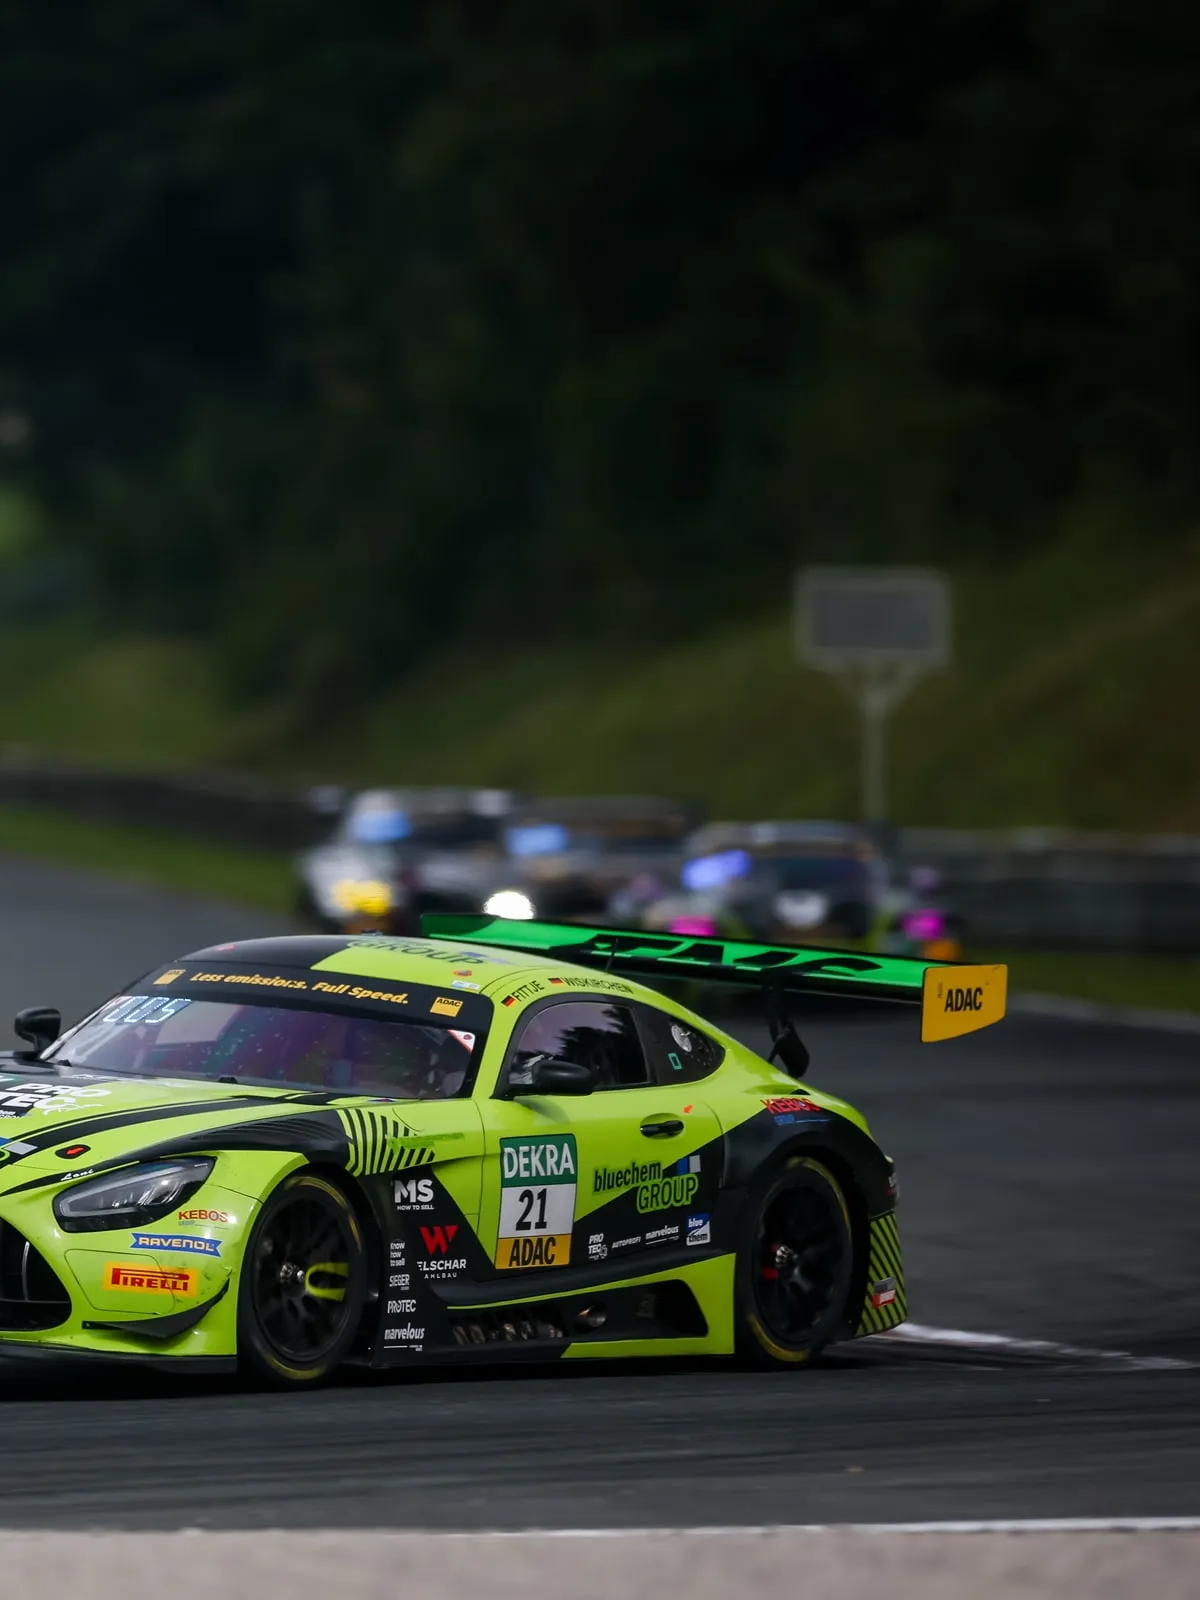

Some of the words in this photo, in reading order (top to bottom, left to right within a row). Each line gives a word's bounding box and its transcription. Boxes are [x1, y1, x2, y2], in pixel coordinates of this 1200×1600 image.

[189, 972, 225, 982] Less
[312, 981, 351, 995] Full
[348, 986, 409, 1005] Speed.
[511, 980, 545, 1002] FITTJE
[561, 977, 634, 994] WISKIRCHEN
[437, 998, 461, 1008] ADAC
[944, 987, 984, 1013] ADAC
[5, 1083, 112, 1098] PRO
[503, 1143, 575, 1179] DEKRA
[593, 1162, 661, 1192] bluechem
[395, 1179, 434, 1203] MS
[638, 1177, 696, 1210] GROUP
[178, 1209, 229, 1223] KEBOS
[515, 1188, 548, 1231] 21
[589, 1233, 604, 1244] PRO
[645, 1225, 679, 1240] marvelous
[138, 1237, 215, 1251] RAVENOL
[508, 1236, 557, 1267] ADAC
[111, 1268, 190, 1291] PIRELLI
[387, 1300, 417, 1313] PROTEC
[384, 1322, 425, 1340] marvelous
